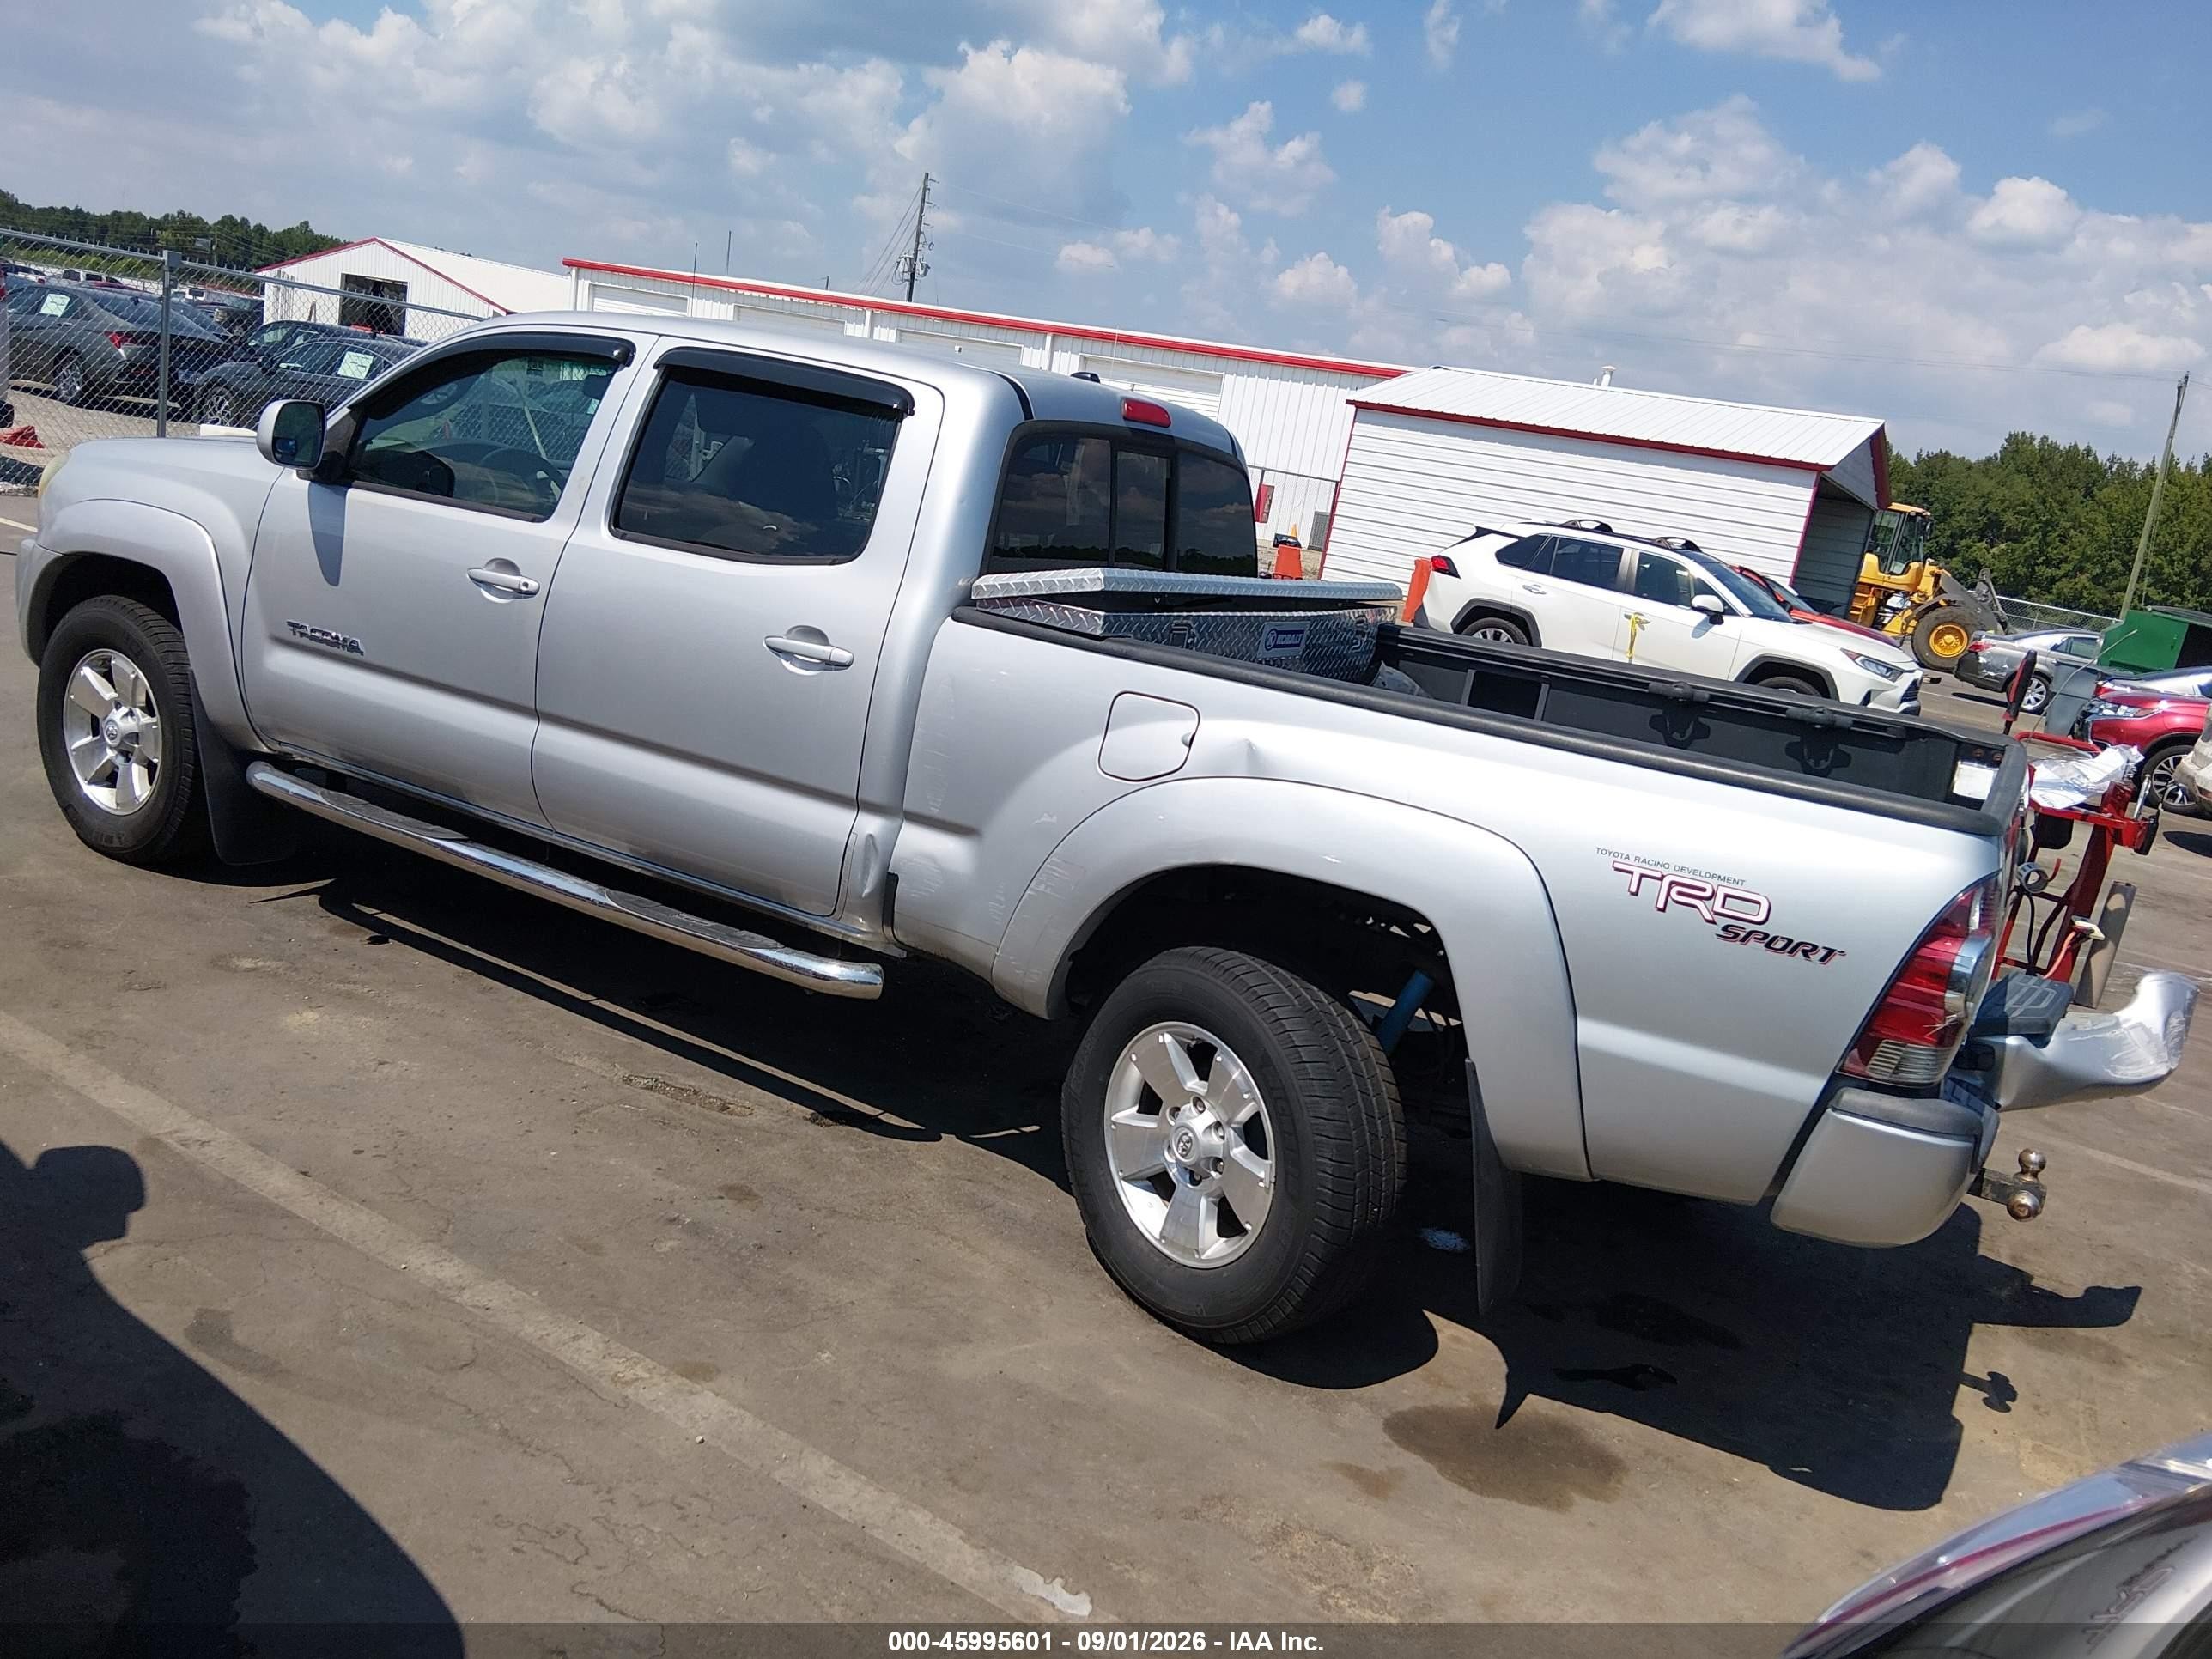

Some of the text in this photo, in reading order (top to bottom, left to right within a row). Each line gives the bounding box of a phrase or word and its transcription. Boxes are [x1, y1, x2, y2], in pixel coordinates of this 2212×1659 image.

[1595, 847, 1746, 887] TOYOTA RACING DEVELOPMENT
[1612, 860, 1771, 925] TRD
[1716, 923, 1847, 965] SPORT
